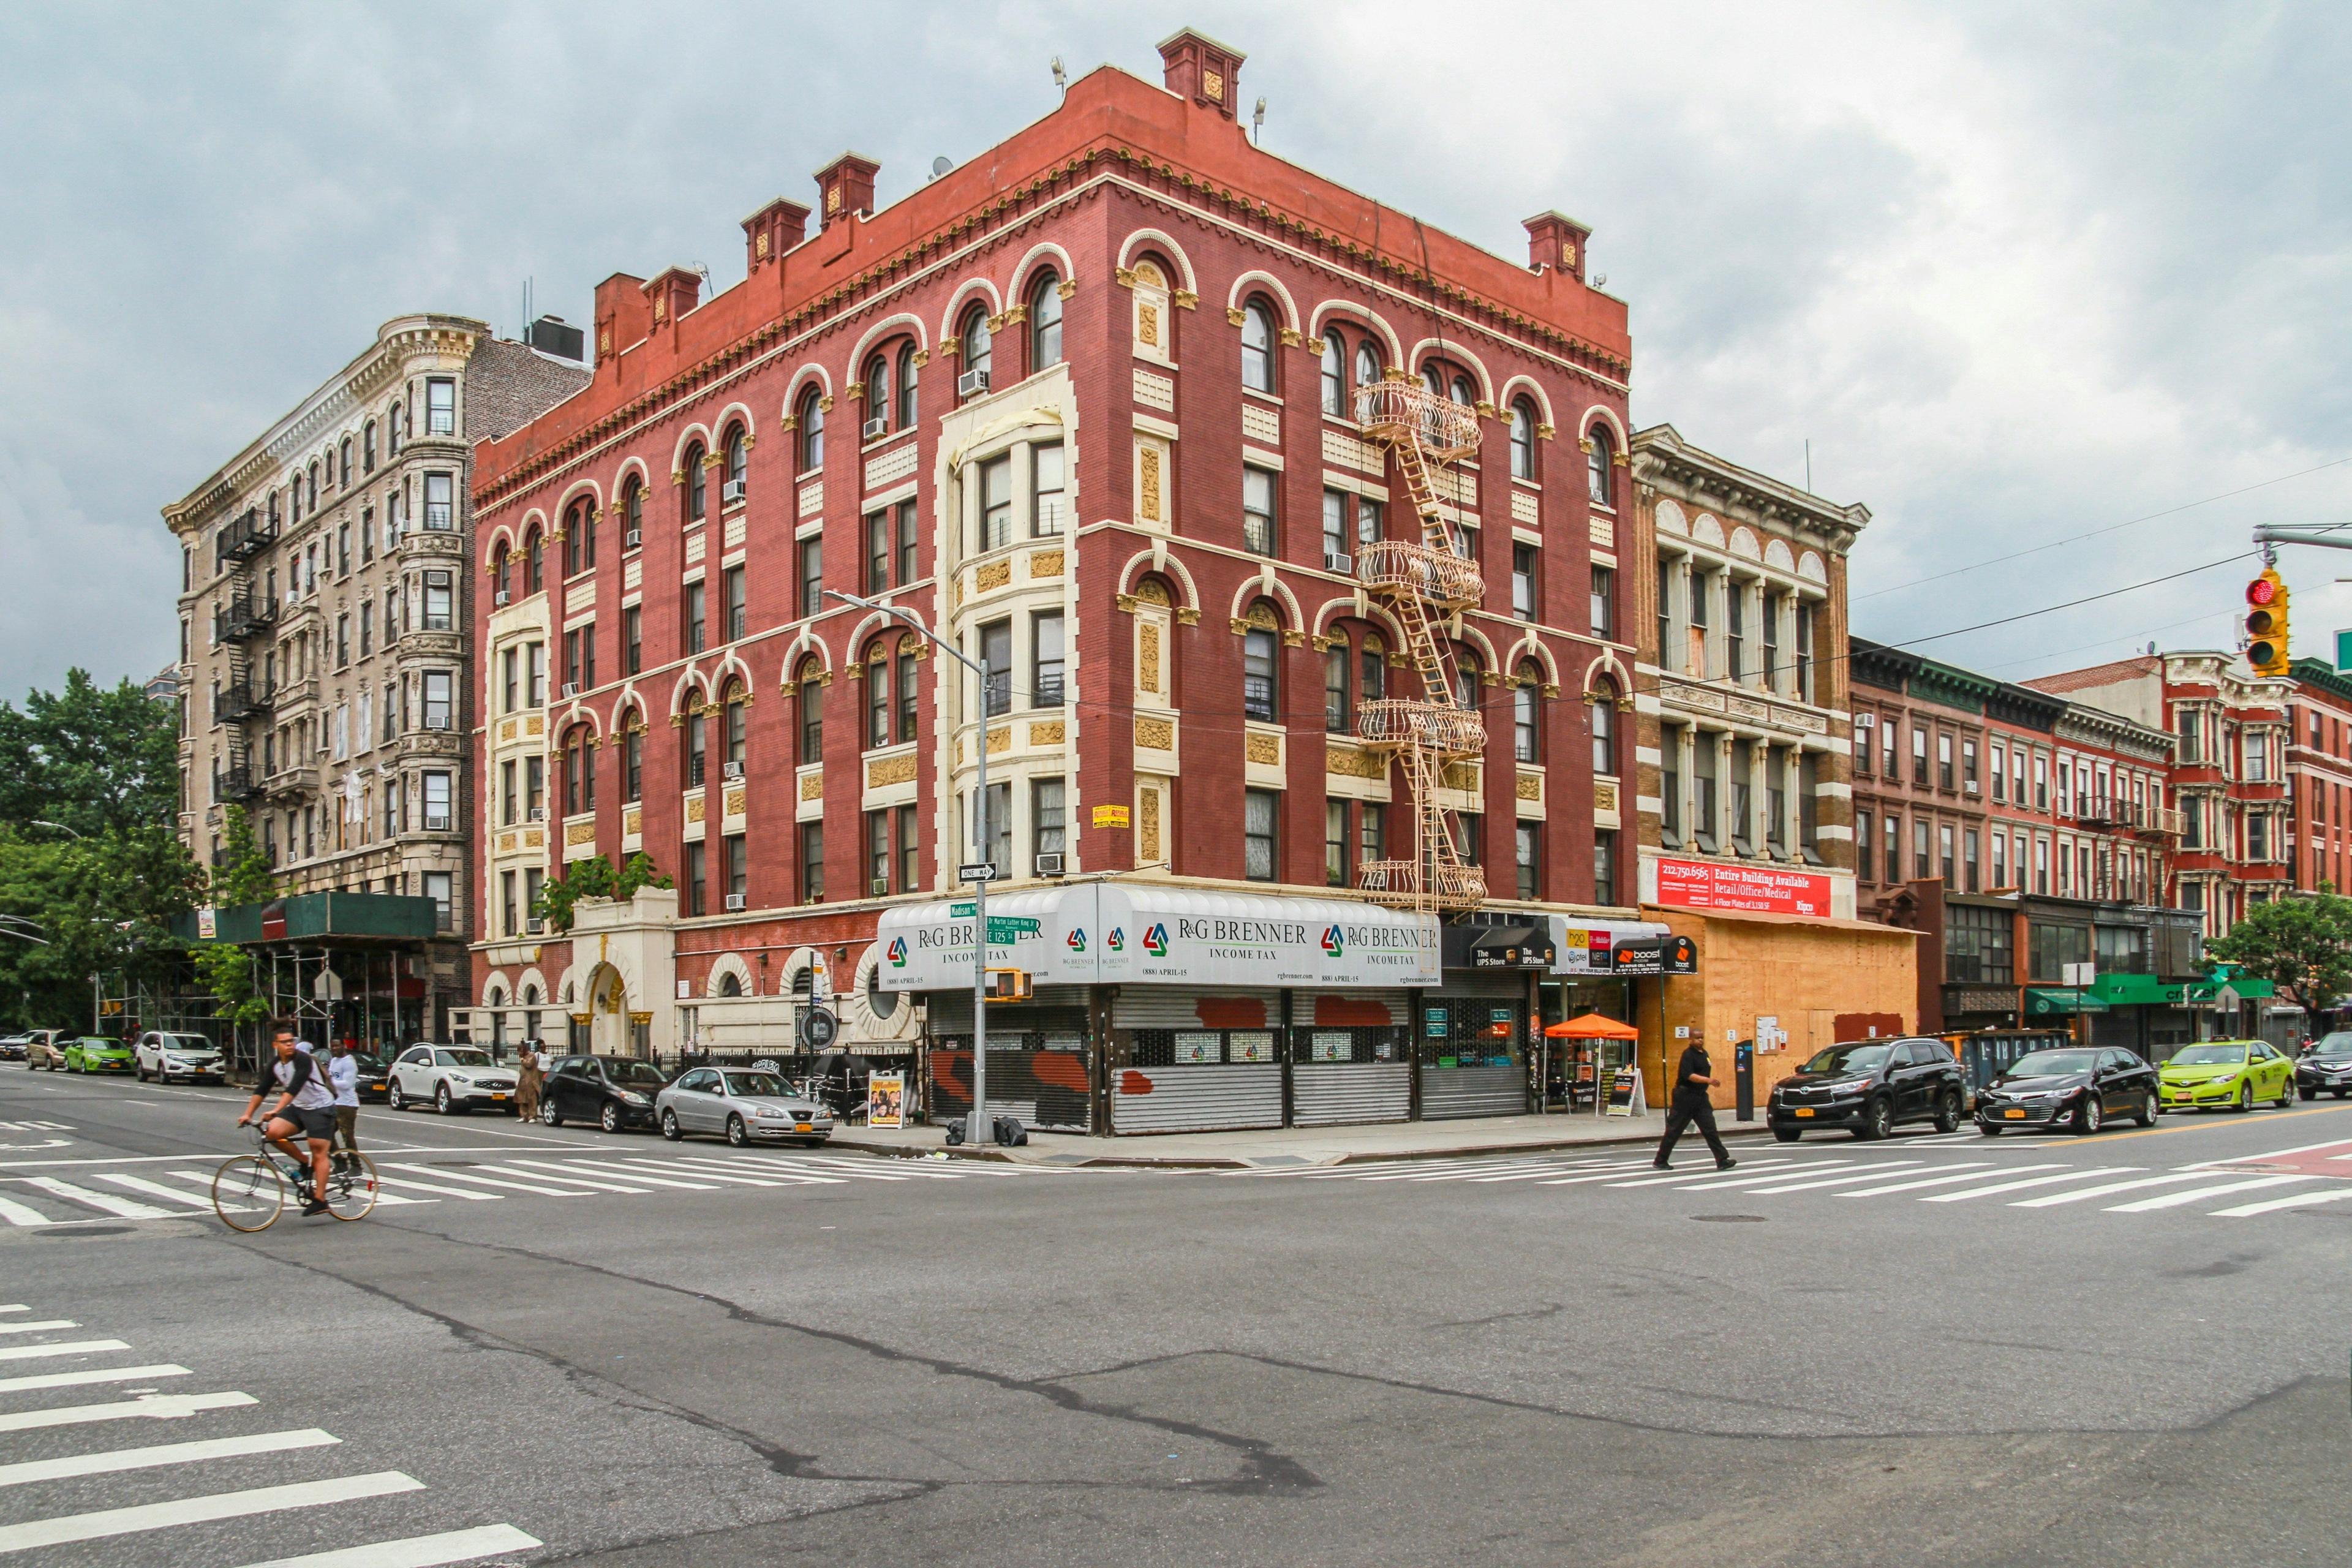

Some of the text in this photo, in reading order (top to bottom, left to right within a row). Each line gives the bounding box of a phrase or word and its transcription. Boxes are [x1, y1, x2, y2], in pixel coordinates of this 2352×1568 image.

[1662, 865, 1708, 881] 212.750.6565
[1715, 869, 1809, 888] Entire Building Available
[1715, 883, 1792, 900] Retail/Office/Medical
[951, 905, 970, 916] Madison
[1796, 901, 1813, 914] Ripco
[1020, 919, 1029, 928] King
[919, 927, 943, 948] R&G
[989, 932, 992, 941] E
[995, 932, 1006, 942] 125
[1179, 919, 1307, 944] R&G BRENNER
[1348, 927, 1437, 948] R&G BRENNER
[943, 950, 1008, 963] INCOM TAX
[1210, 948, 1276, 960] INCOME TAX
[1367, 955, 1414, 965] INCOME TAX
[1634, 949, 1660, 959] boost
